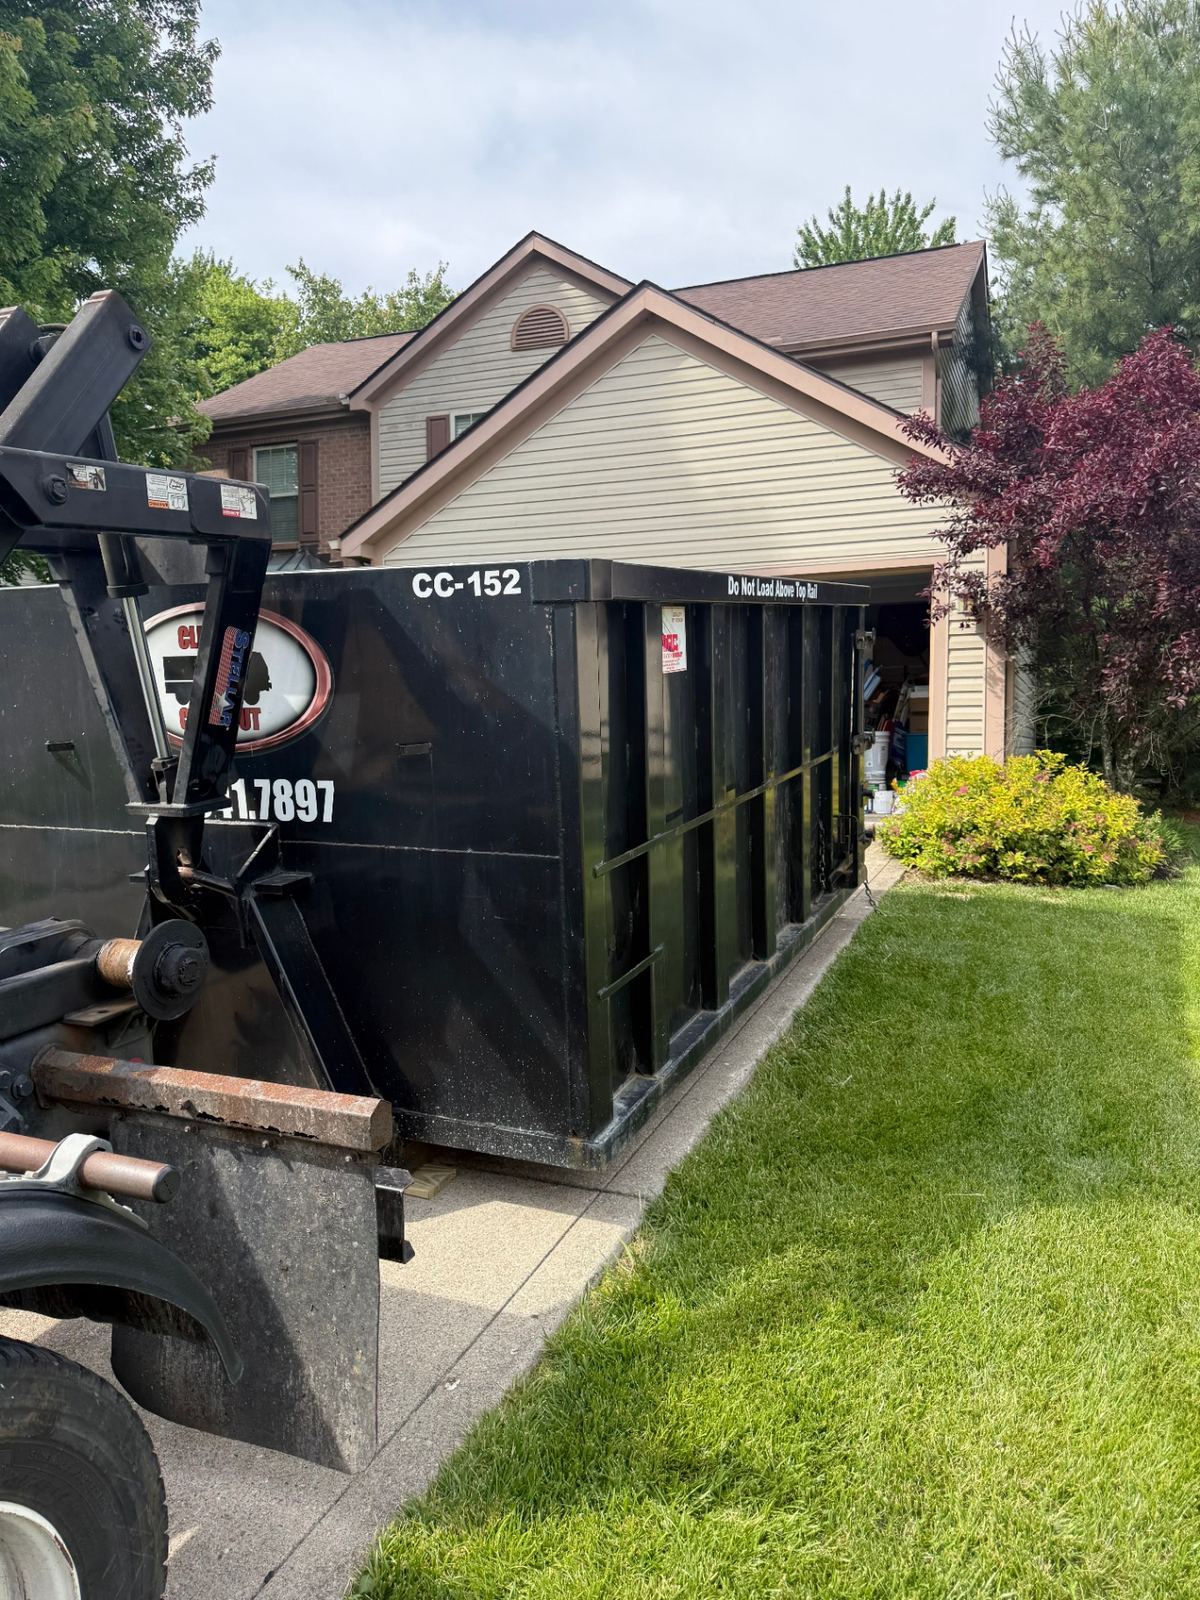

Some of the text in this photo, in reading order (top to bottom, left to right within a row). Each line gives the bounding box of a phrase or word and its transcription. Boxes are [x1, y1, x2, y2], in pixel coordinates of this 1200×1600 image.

[412, 568, 522, 598] CC-152
[727, 575, 818, 602] Do Not Load Above Top Rail
[219, 630, 250, 727] STELLAR
[204, 778, 335, 823] 1.7897
